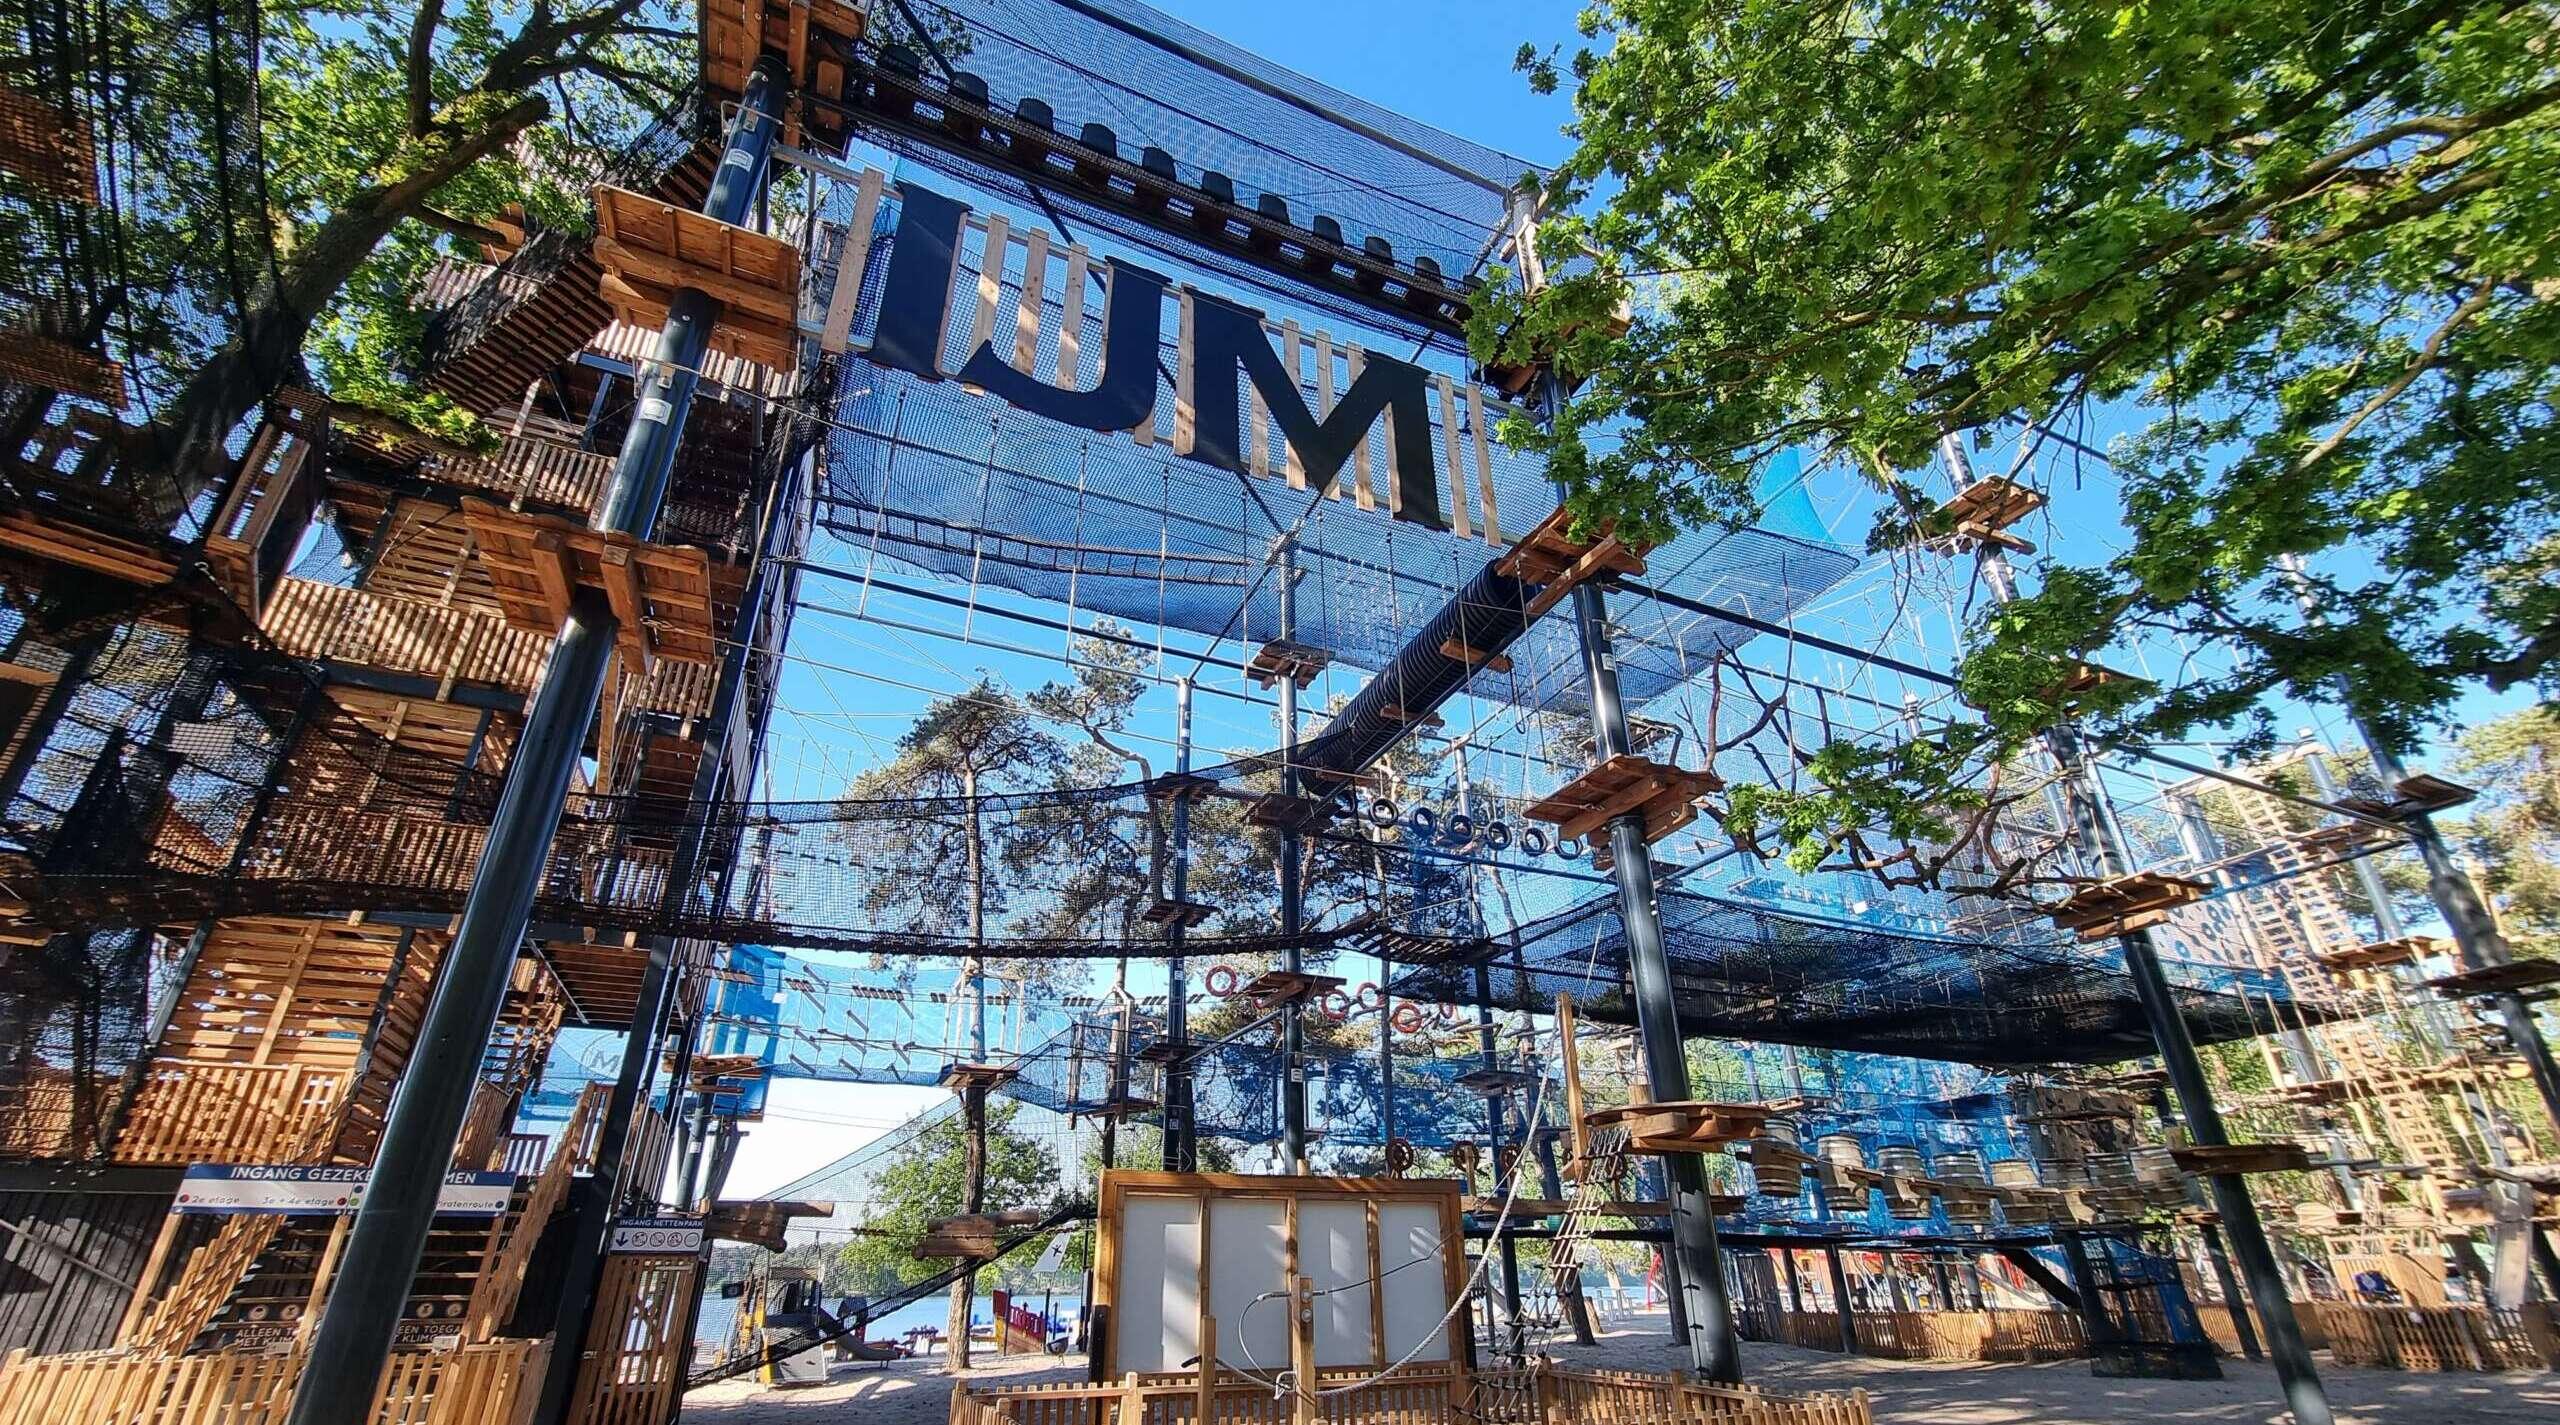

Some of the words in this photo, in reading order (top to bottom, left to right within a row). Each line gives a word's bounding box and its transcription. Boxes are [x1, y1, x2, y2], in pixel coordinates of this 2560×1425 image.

[230, 1166, 301, 1180] INGANG
[620, 1219, 651, 1227] INGANG
[236, 1327, 281, 1338] ALLEEN
